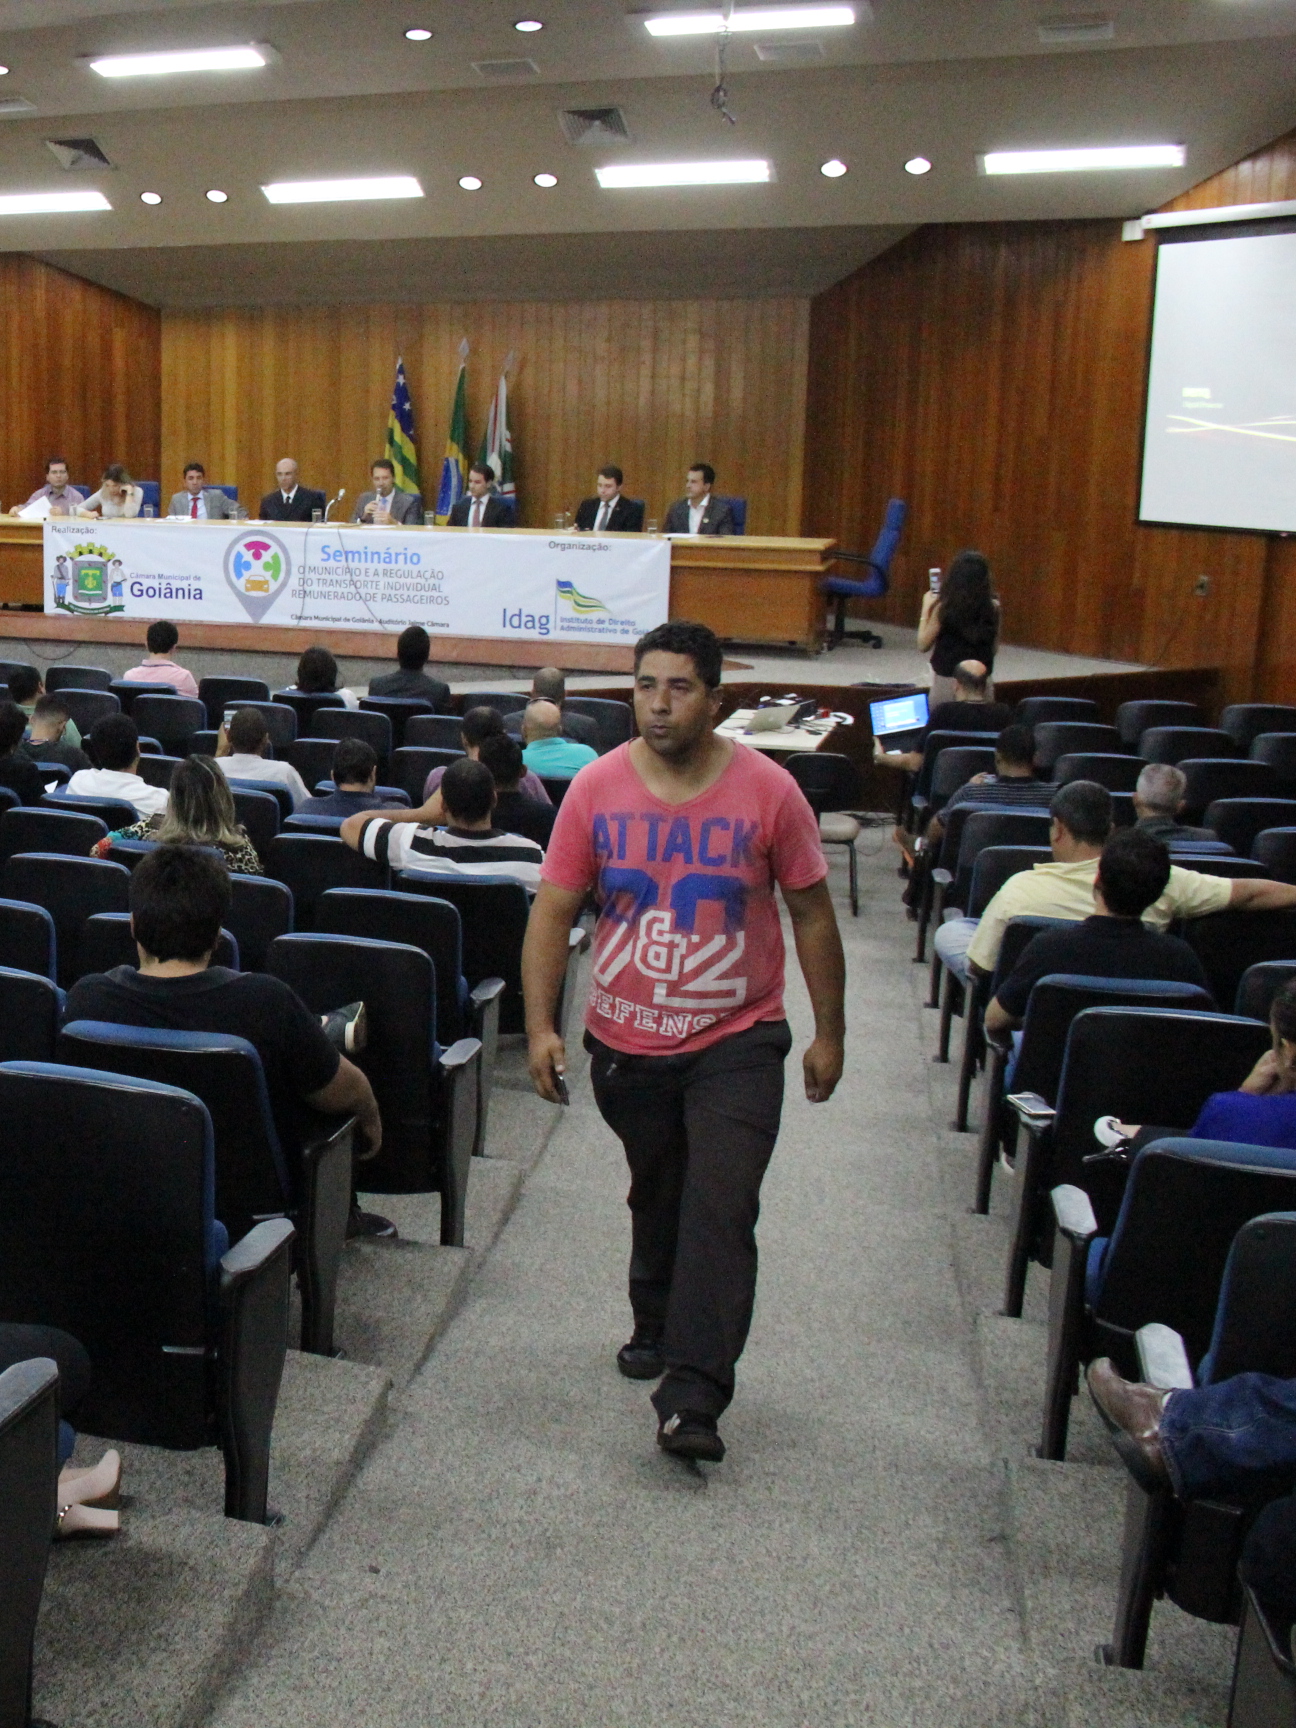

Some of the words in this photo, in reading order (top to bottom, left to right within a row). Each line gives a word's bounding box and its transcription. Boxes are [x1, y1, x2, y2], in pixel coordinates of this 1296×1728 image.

[51, 525, 98, 535] Realização:
[548, 540, 612, 552] Organização:
[320, 545, 421, 566] Seminário
[129, 572, 156, 580] Câmara
[157, 573, 191, 582] Municipal
[297, 565, 305, 575] O
[307, 564, 362, 577] MUNICÍPIO
[364, 567, 371, 577] E
[372, 568, 380, 578] A
[382, 568, 444, 582] REGULAÇÃO
[129, 581, 203, 600] Goiânia
[298, 577, 313, 587] DO
[316, 578, 381, 590] TRANSPORTE
[383, 581, 443, 593] INDIVIDUAL
[291, 589, 362, 602] REMUNERADO
[364, 592, 378, 602] DE
[381, 593, 450, 606] PASSAGEIROS
[426, 620, 450, 628] Câmara
[502, 608, 551, 636] Idag
[559, 616, 594, 625] Instituto
[595, 617, 605, 625] de
[608, 617, 636, 627] Direito
[559, 625, 618, 635] Administrativo
[619, 627, 630, 635] de
[592, 811, 758, 869] ATTACK
[589, 984, 731, 1038] EFENS
